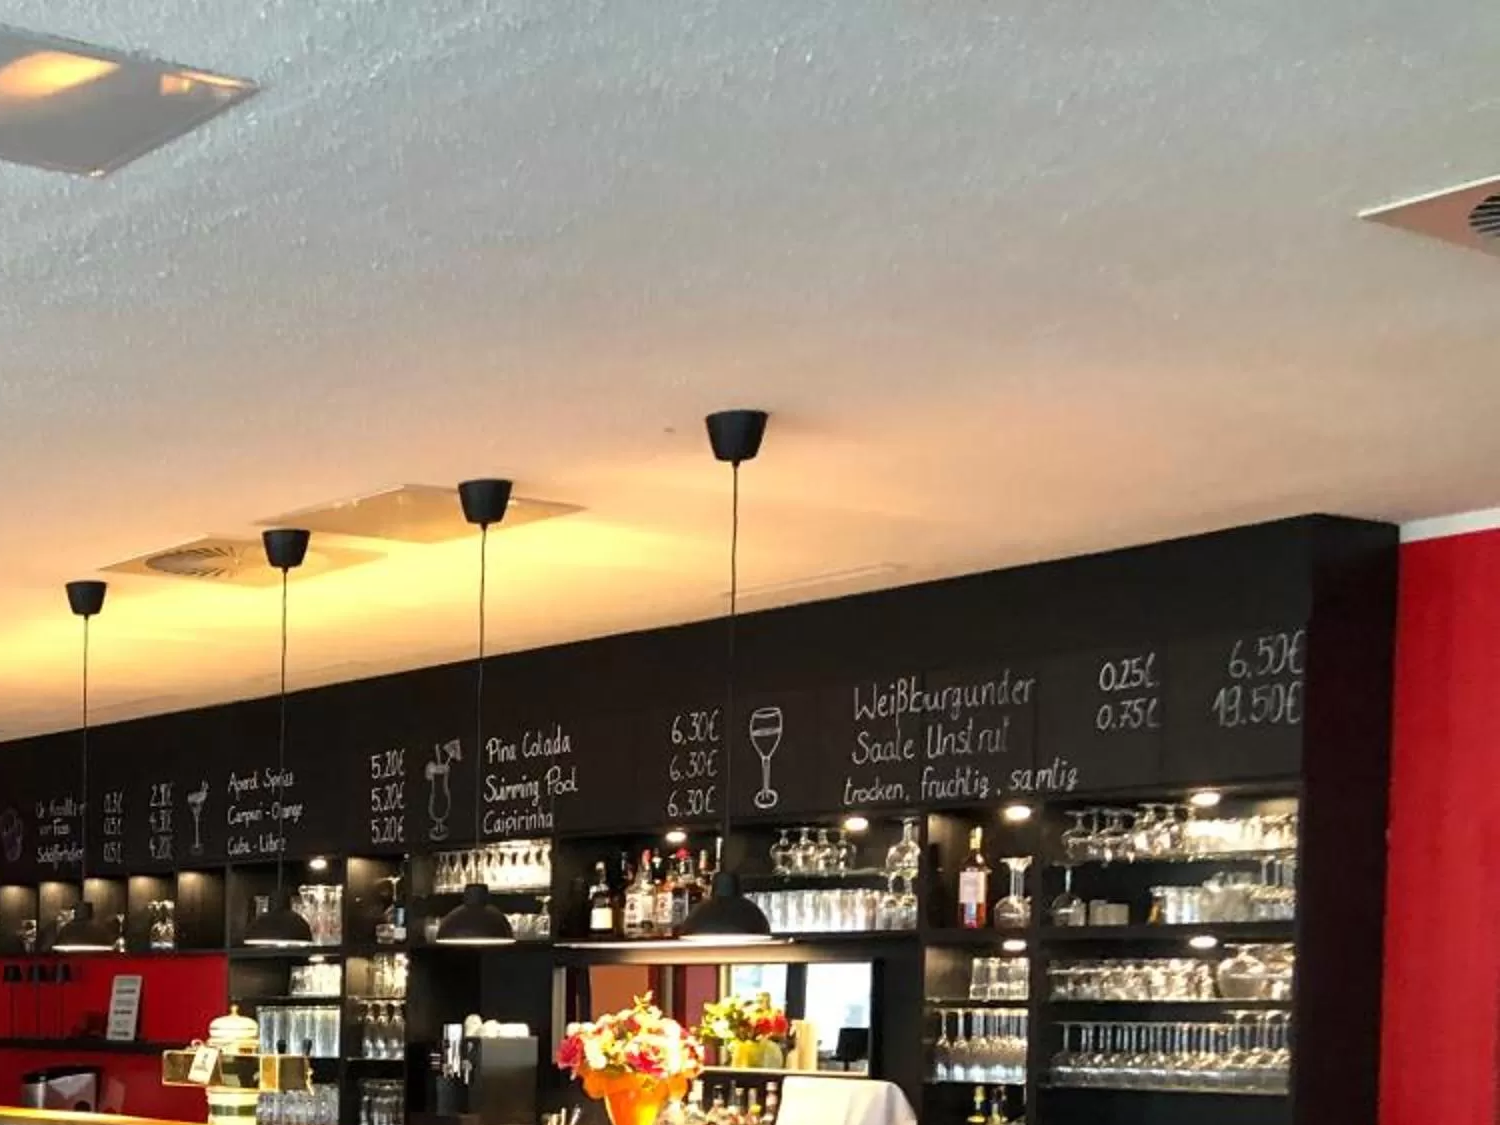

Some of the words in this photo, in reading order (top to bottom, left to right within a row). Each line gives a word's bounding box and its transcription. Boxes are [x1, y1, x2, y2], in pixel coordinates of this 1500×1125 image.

[1228, 628, 1305, 679] 6.50€
[522, 724, 572, 758] Colada
[851, 728, 915, 765] Saale
